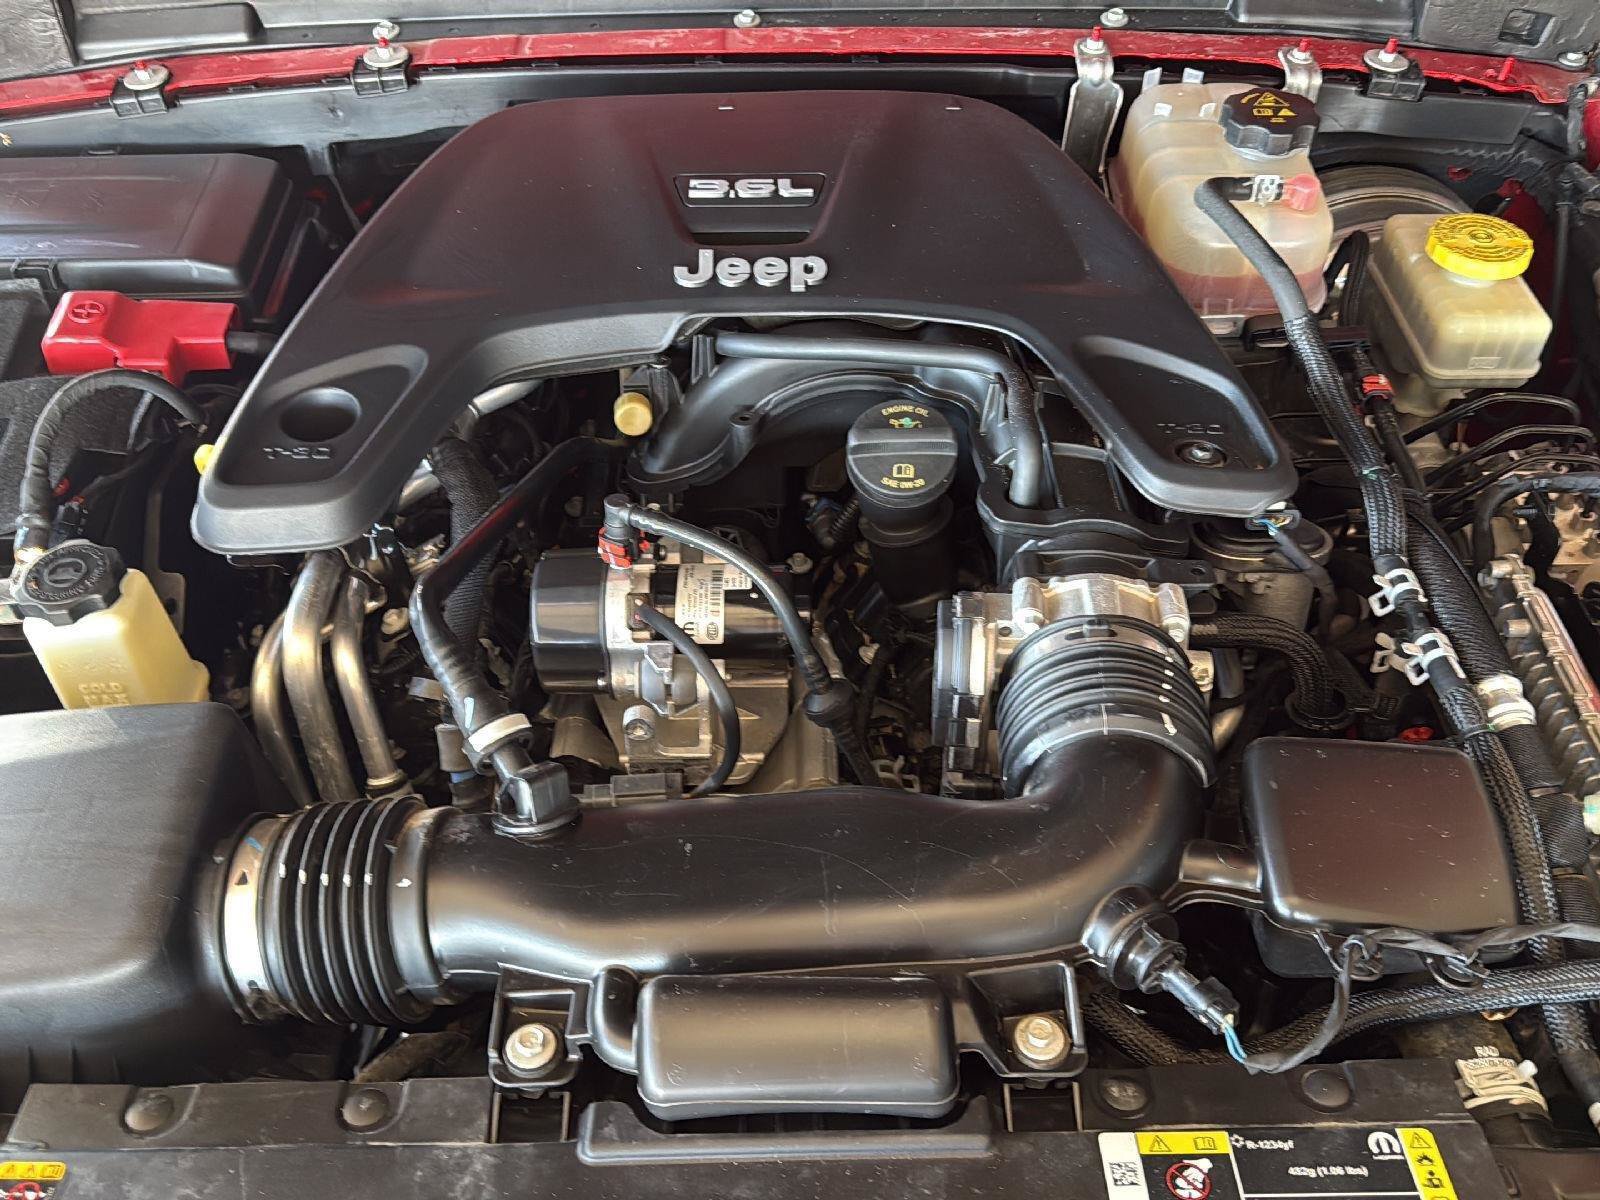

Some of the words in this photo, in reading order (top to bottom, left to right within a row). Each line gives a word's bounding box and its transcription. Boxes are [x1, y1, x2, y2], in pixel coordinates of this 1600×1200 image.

[688, 178, 814, 199] 3.6L
[673, 248, 828, 293] Jeep
[881, 405, 914, 415] ENGINE
[915, 405, 929, 417] OIL
[77, 681, 124, 694] COLD
